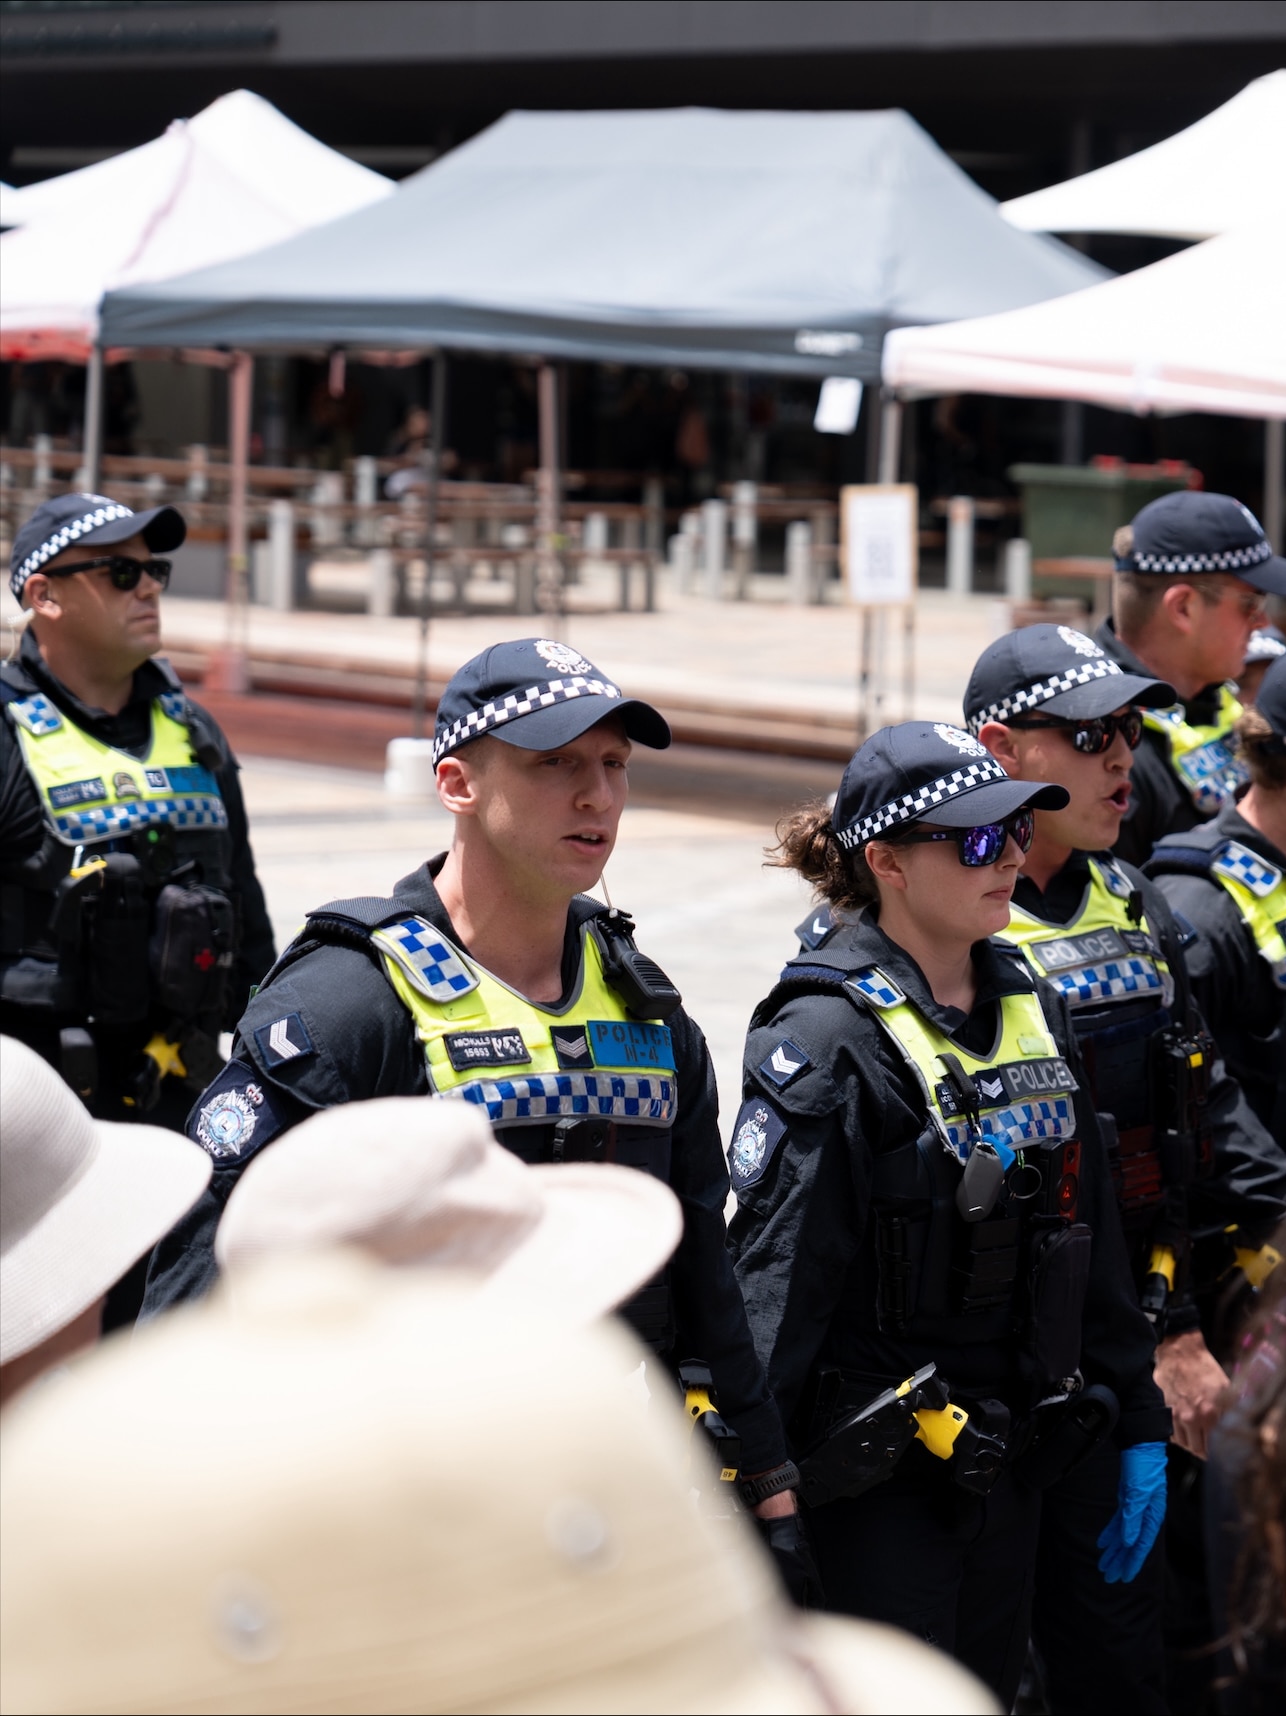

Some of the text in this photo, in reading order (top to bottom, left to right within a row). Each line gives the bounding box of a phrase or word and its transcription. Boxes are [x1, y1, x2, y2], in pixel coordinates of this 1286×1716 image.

[546, 660, 592, 675] POLICE
[1040, 934, 1119, 965] POLICE
[595, 1023, 672, 1047] POLICE
[1006, 1061, 1071, 1093] POLICE
